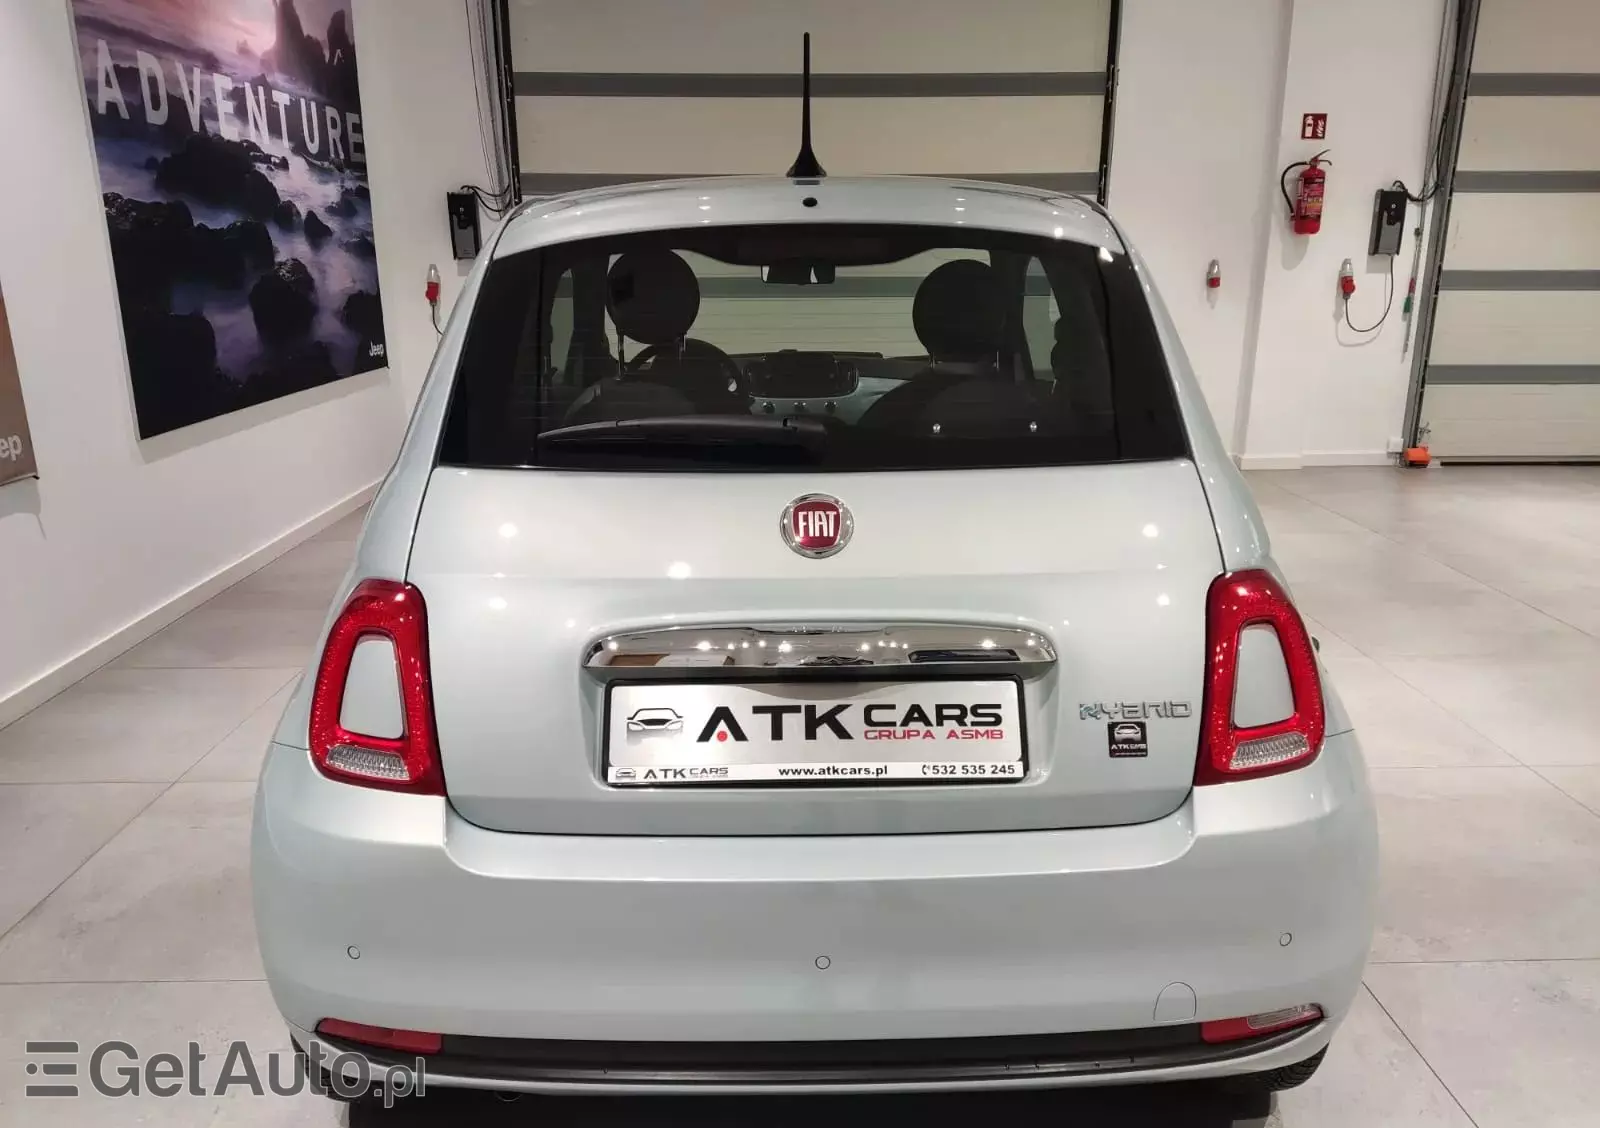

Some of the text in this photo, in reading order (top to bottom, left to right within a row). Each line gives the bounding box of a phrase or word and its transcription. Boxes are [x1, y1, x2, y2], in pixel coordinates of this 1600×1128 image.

[97, 39, 365, 162] ADVENTURE
[369, 341, 384, 357] Jeep
[798, 511, 837, 537] FIAT
[1080, 701, 1192, 720] HYBRID
[696, 703, 1003, 742] ATK CARS
[864, 729, 1004, 740] GRUPA ASMB
[643, 768, 686, 779] ATK
[689, 767, 728, 775] CARS
[779, 765, 888, 778] www.atkcars.pl
[932, 764, 1015, 775] 532 535 245
